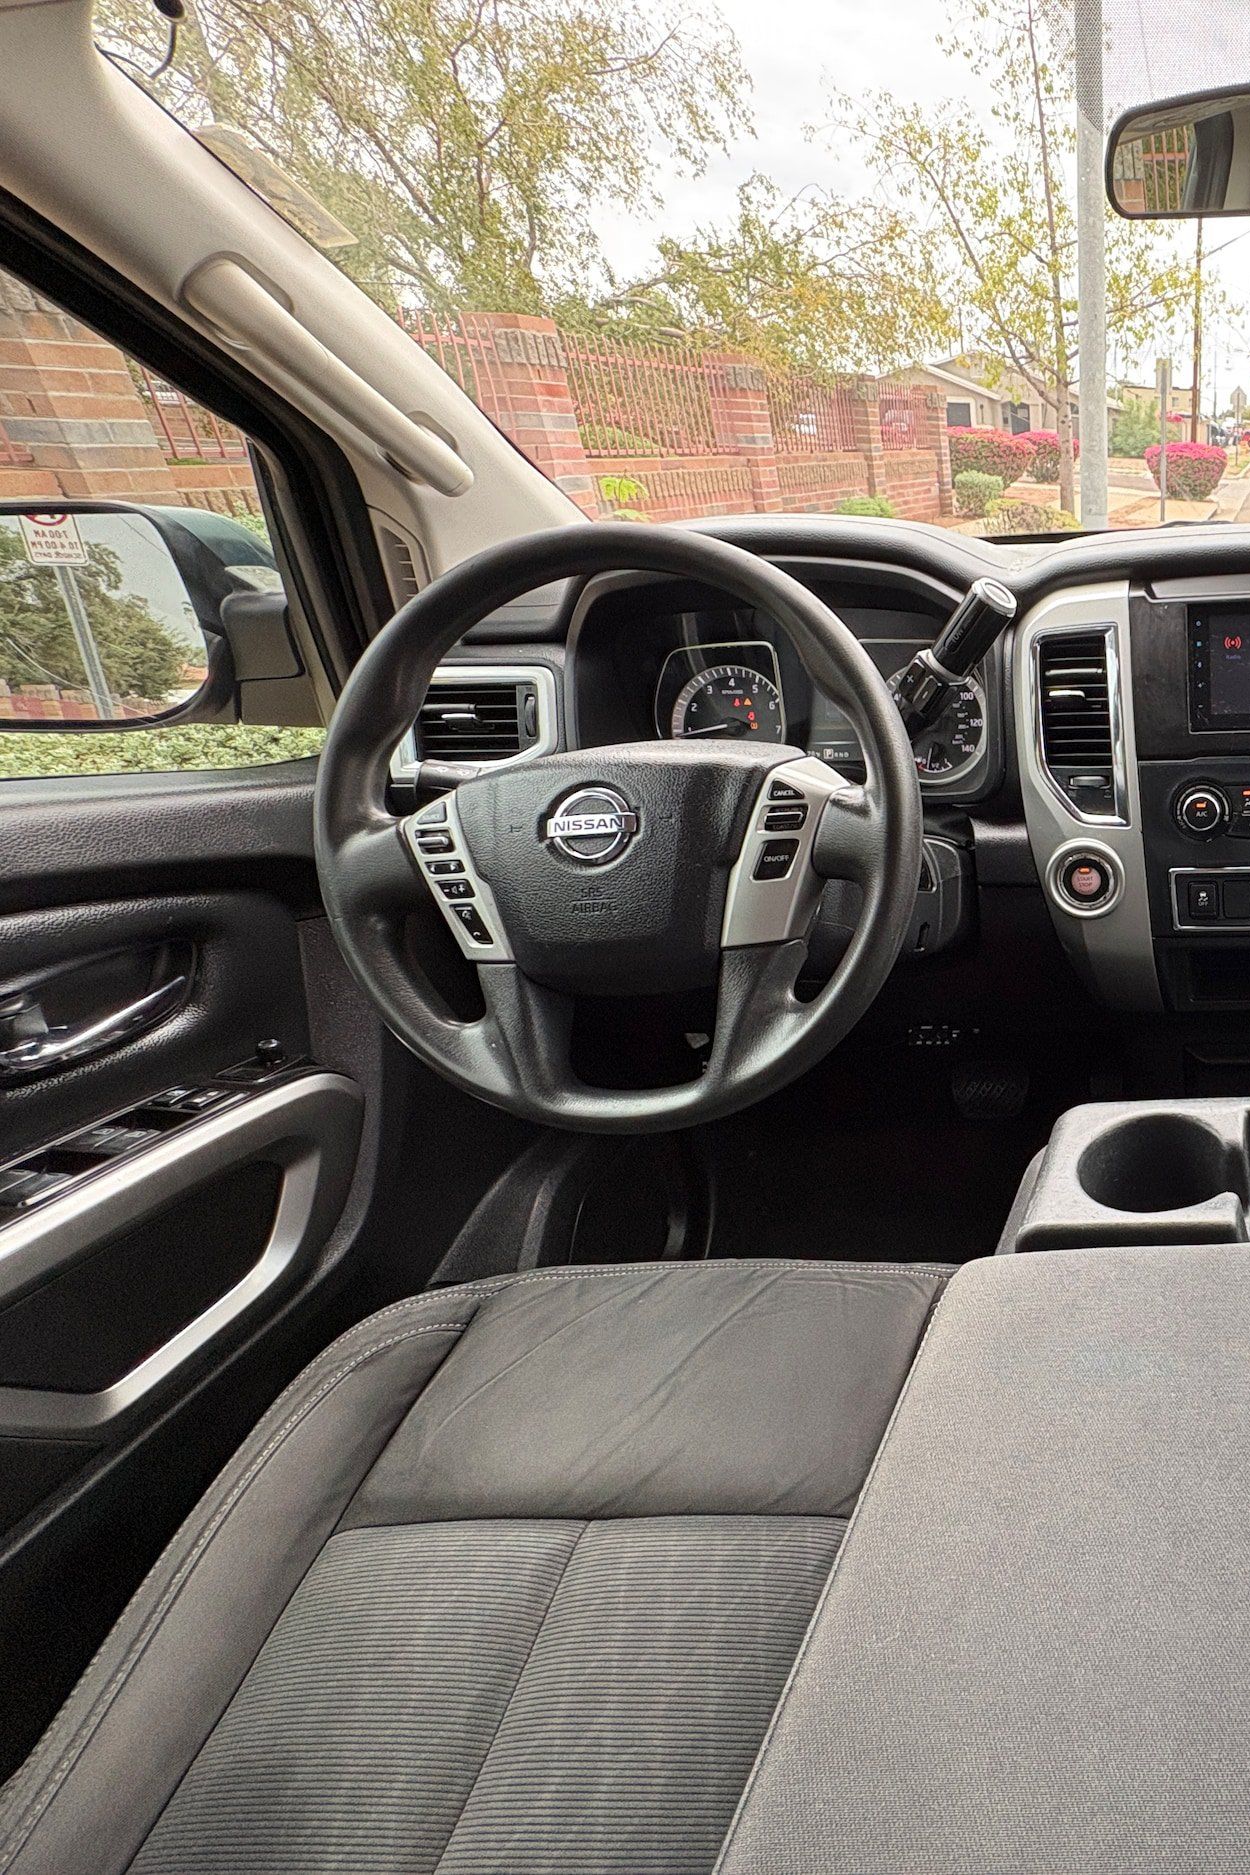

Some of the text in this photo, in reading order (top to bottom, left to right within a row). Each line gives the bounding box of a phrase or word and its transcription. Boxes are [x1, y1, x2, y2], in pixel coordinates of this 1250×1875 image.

[728, 678, 735, 687] 4
[707, 685, 713, 695] 3
[752, 684, 759, 694] 5
[960, 692, 974, 700] 100
[691, 702, 697, 712] 2
[768, 701, 776, 710] 6
[969, 718, 983, 727] 120
[775, 725, 782, 734] 7
[961, 744, 975, 753] 140
[773, 789, 795, 797] CANCEL
[554, 818, 623, 833] NISSAN
[763, 854, 789, 862] ON/OFF
